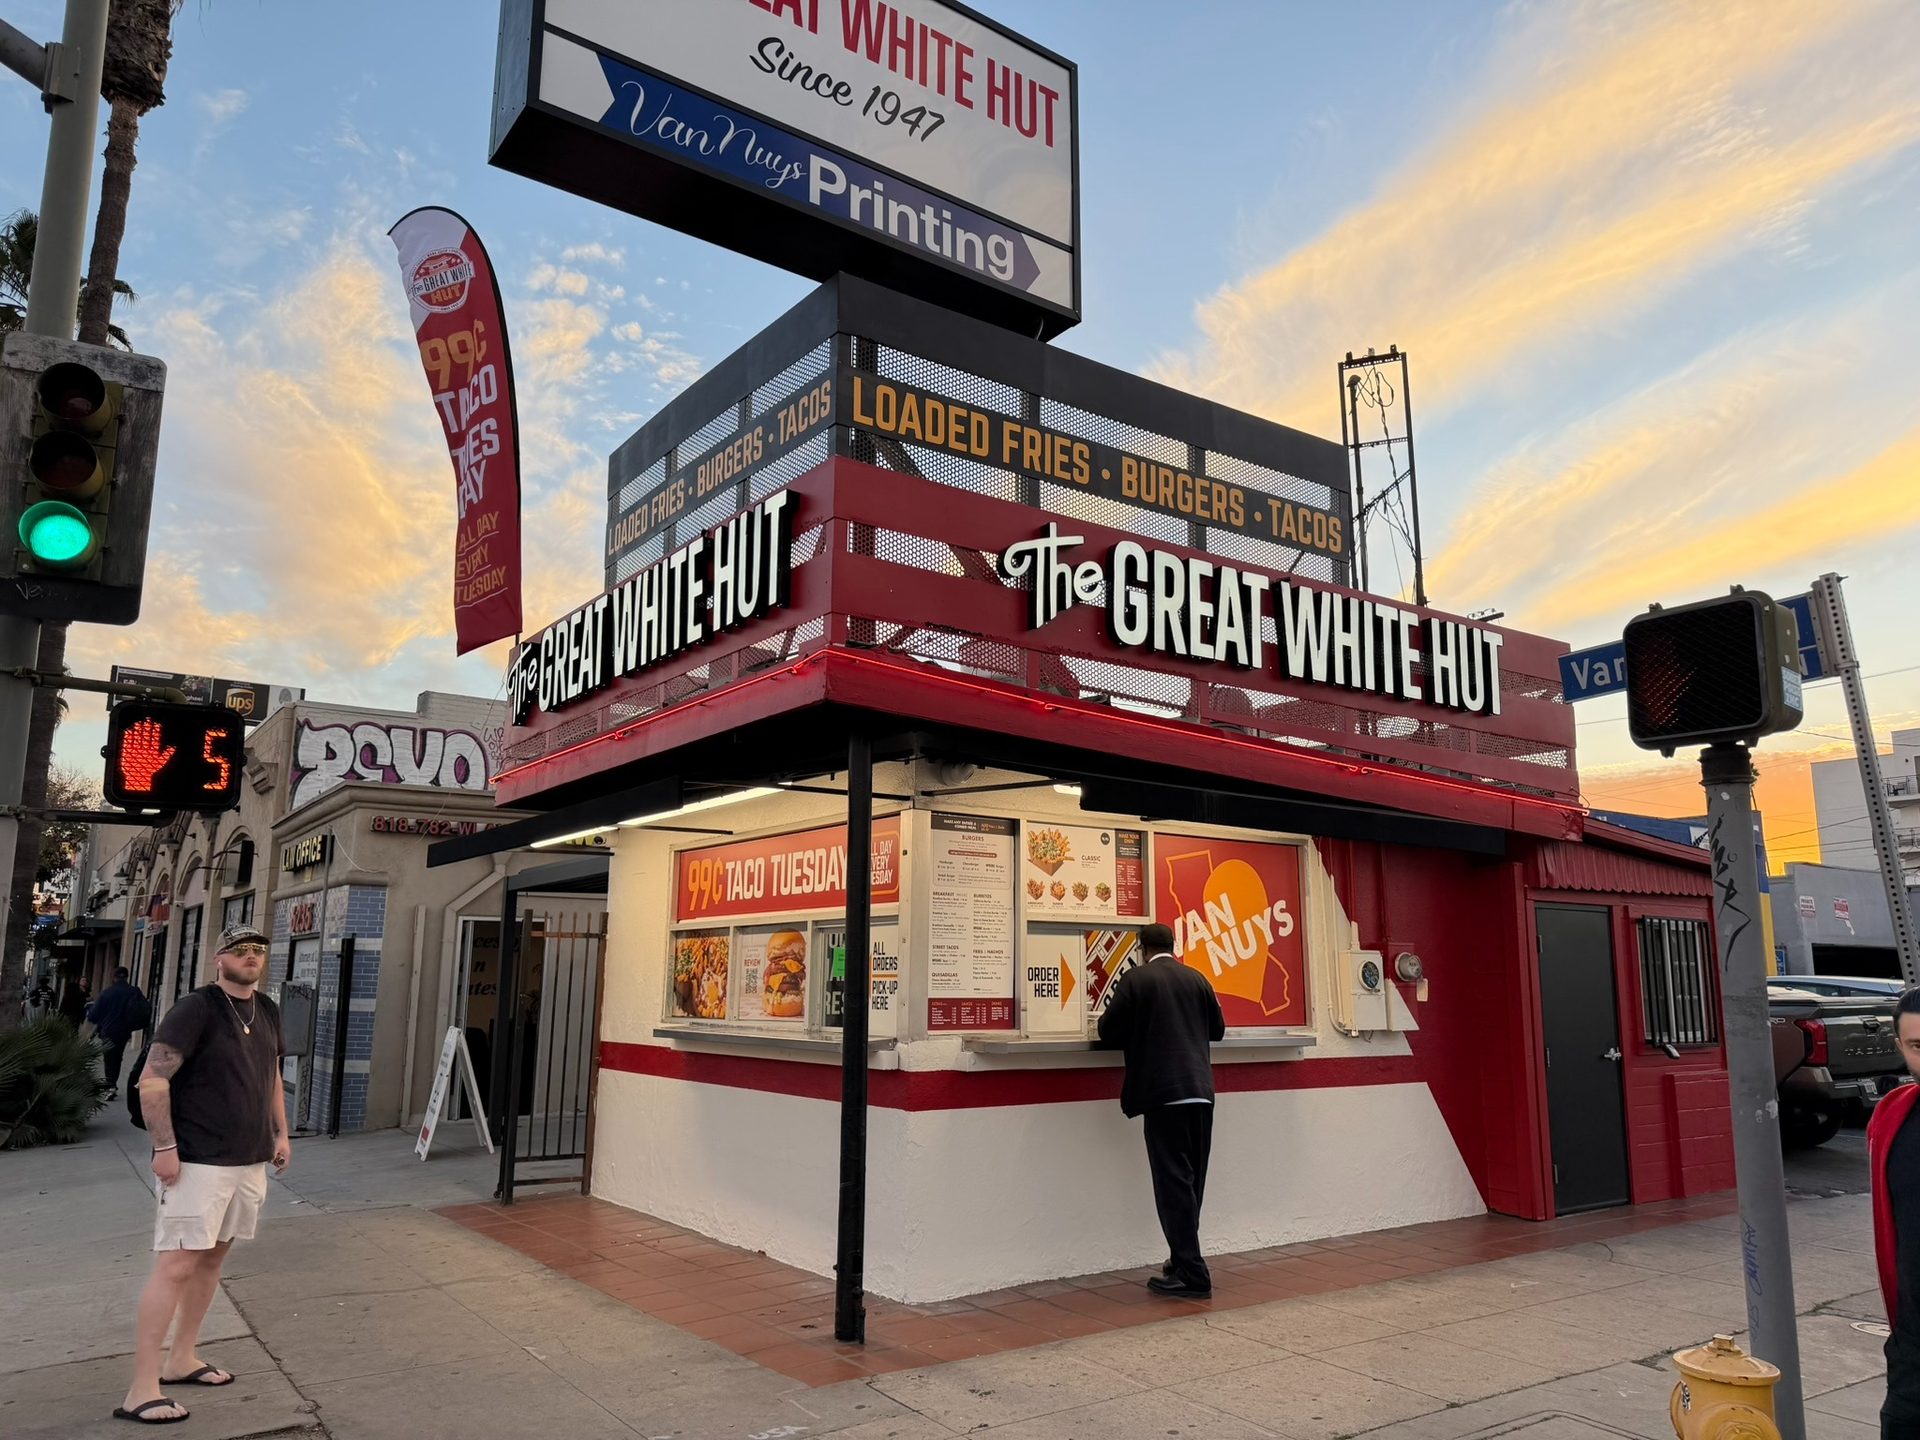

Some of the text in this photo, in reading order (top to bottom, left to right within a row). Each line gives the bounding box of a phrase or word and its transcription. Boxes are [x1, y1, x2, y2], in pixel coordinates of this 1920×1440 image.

[749, 37, 945, 142] Since 1947
[840, 0, 974, 110] WHITE
[987, 57, 1059, 148] HUT
[621, 81, 1014, 281] Van Nuys Printing
[423, 270, 450, 292] GREAT
[450, 263, 472, 282] WHITE
[430, 284, 461, 304] HUT
[419, 318, 487, 390] 99¢
[433, 364, 498, 433] TACO
[451, 417, 500, 483] TUES
[608, 379, 831, 556] LOADED FRIES BURGERS TACOS
[853, 376, 1342, 554] LOADED FRIES BURGERS TACOS
[477, 511, 499, 536] DAY
[456, 544, 488, 577] EVERY
[455, 566, 506, 602] TUESDAY
[506, 489, 787, 725] The GREAT WHITE HUT
[1004, 522, 1504, 716] The GREAT WHITE HUT
[228, 696, 252, 711] ups
[203, 729, 230, 790] 5
[283, 835, 322, 871] LAW OFFICE
[880, 840, 893, 855] DAY
[688, 845, 847, 911] 99¢ TACO TUESDAY
[873, 942, 885, 955] ALL
[1205, 900, 1294, 977] NUYS
[872, 956, 898, 971] ORDERS
[1027, 967, 1059, 981] ORDER
[872, 980, 898, 995] PICK-UP
[872, 996, 889, 1010] HERE
[1034, 983, 1059, 997] HERE
